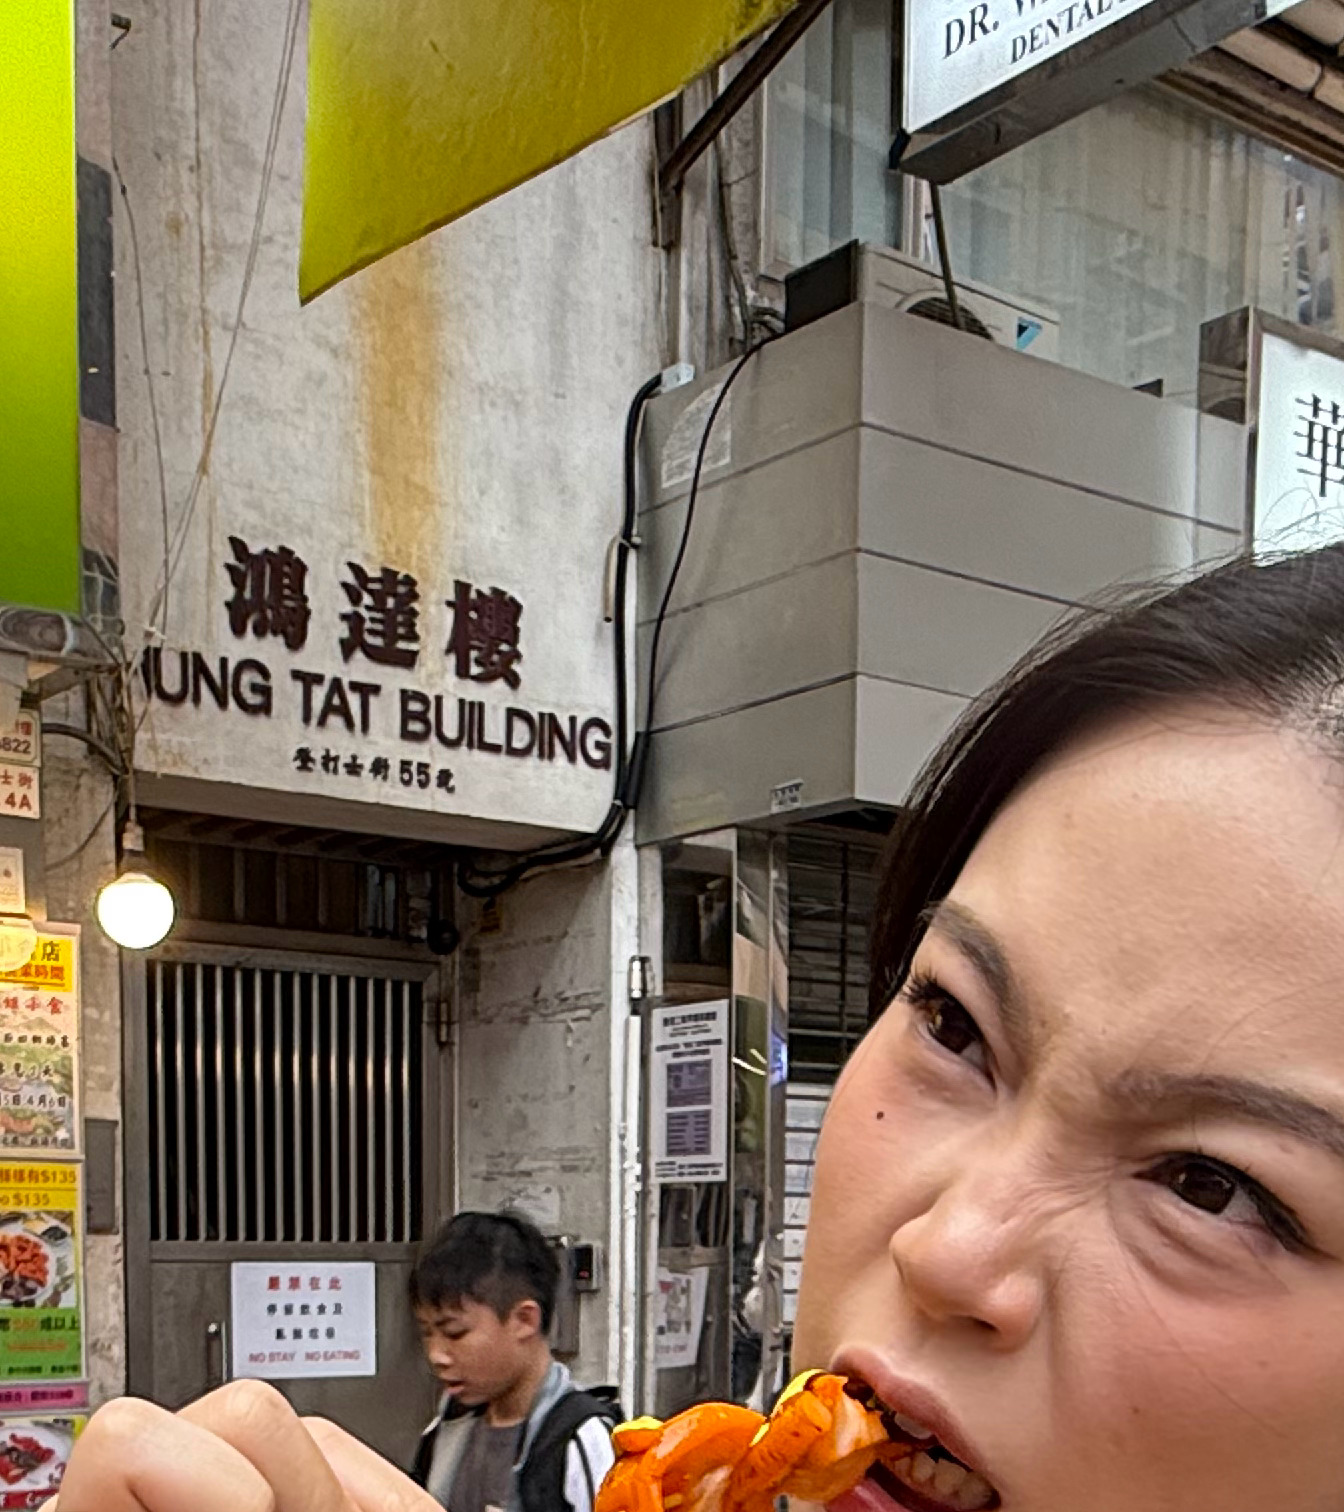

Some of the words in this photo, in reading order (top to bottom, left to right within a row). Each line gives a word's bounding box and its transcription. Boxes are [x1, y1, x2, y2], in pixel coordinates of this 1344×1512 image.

[943, 2, 1000, 60] DR.
[291, 668, 381, 736] TAT
[399, 687, 613, 771] BUILDING
[12, 1192, 51, 1207] $135
[248, 1351, 267, 1363] NO
[304, 1350, 322, 1361] NO
